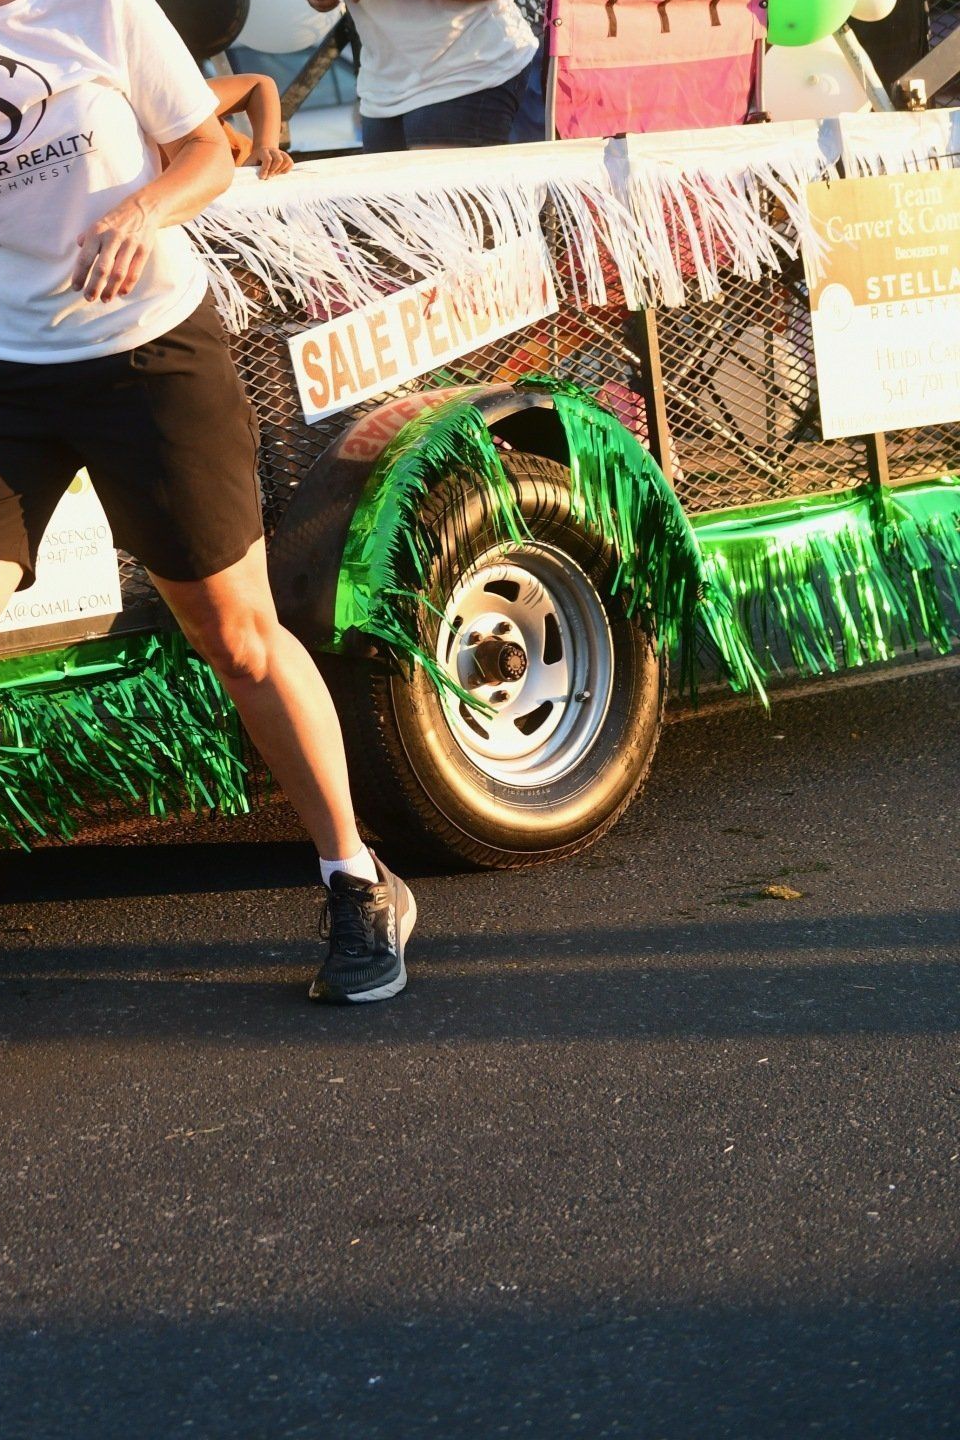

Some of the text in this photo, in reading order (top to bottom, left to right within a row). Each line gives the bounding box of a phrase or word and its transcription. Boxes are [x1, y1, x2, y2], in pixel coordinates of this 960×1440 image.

[16, 130, 95, 171] REALTY
[891, 183, 942, 208] Team
[826, 216, 893, 243] Carver
[898, 209, 915, 237] &
[870, 298, 949, 320] REALTY
[302, 312, 399, 409] SALE
[45, 526, 107, 547] ASCENCIO
